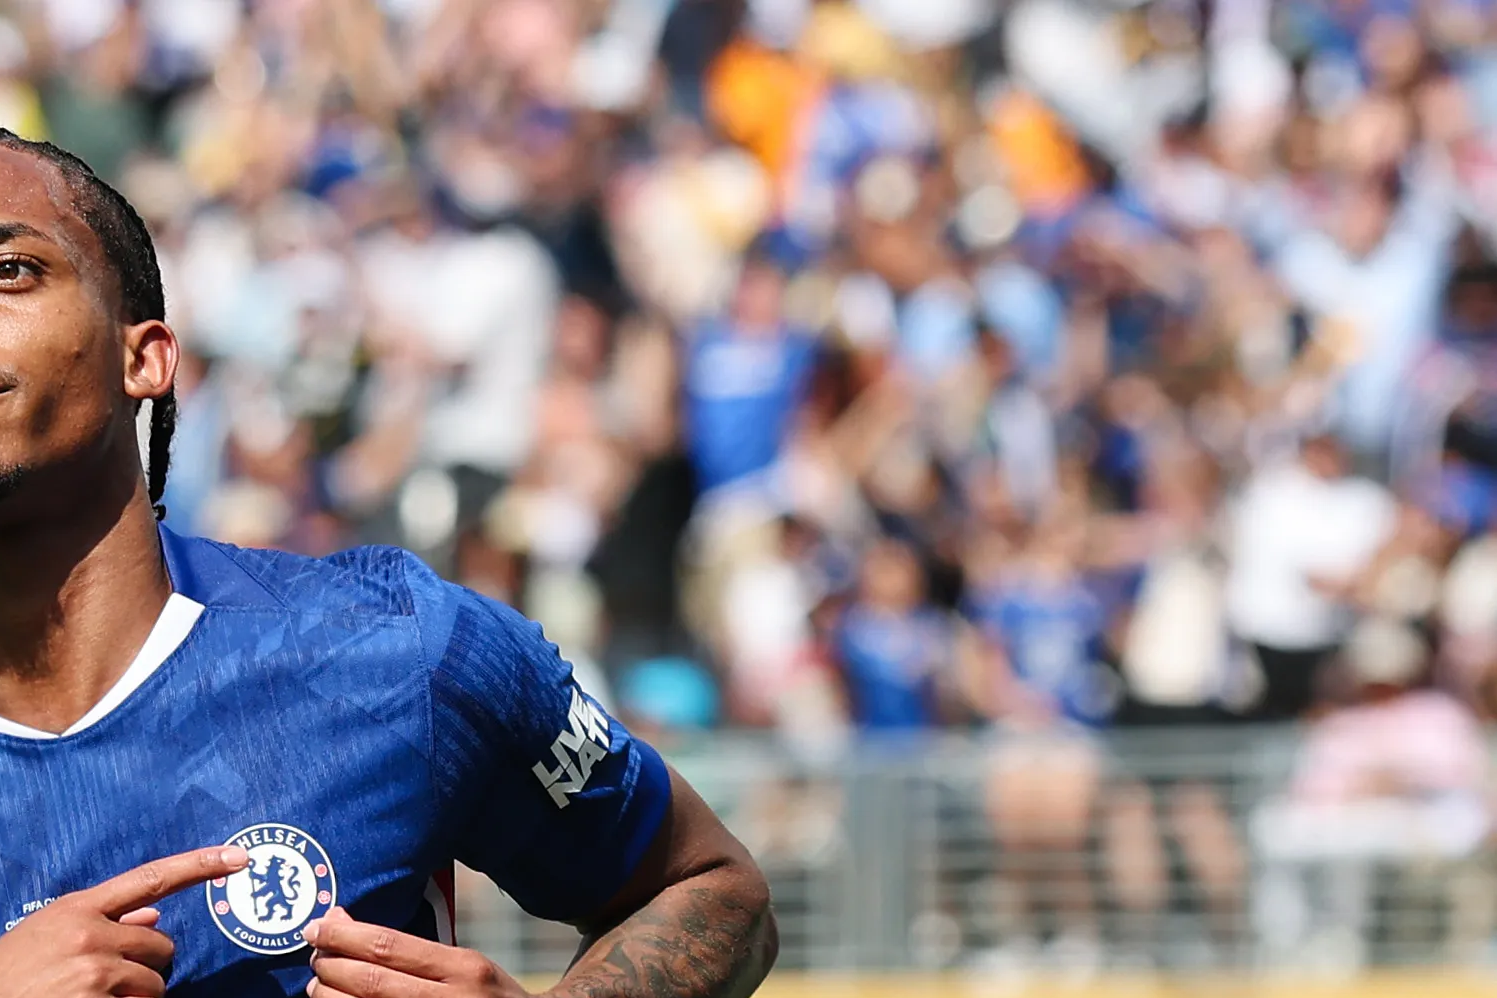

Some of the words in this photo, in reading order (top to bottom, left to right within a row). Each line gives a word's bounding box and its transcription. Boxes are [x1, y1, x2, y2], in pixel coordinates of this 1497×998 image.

[531, 685, 589, 789] LIVE
[236, 828, 308, 854] HELSEA
[23, 900, 43, 914] FIFA
[233, 926, 290, 947] FOOTBALL
